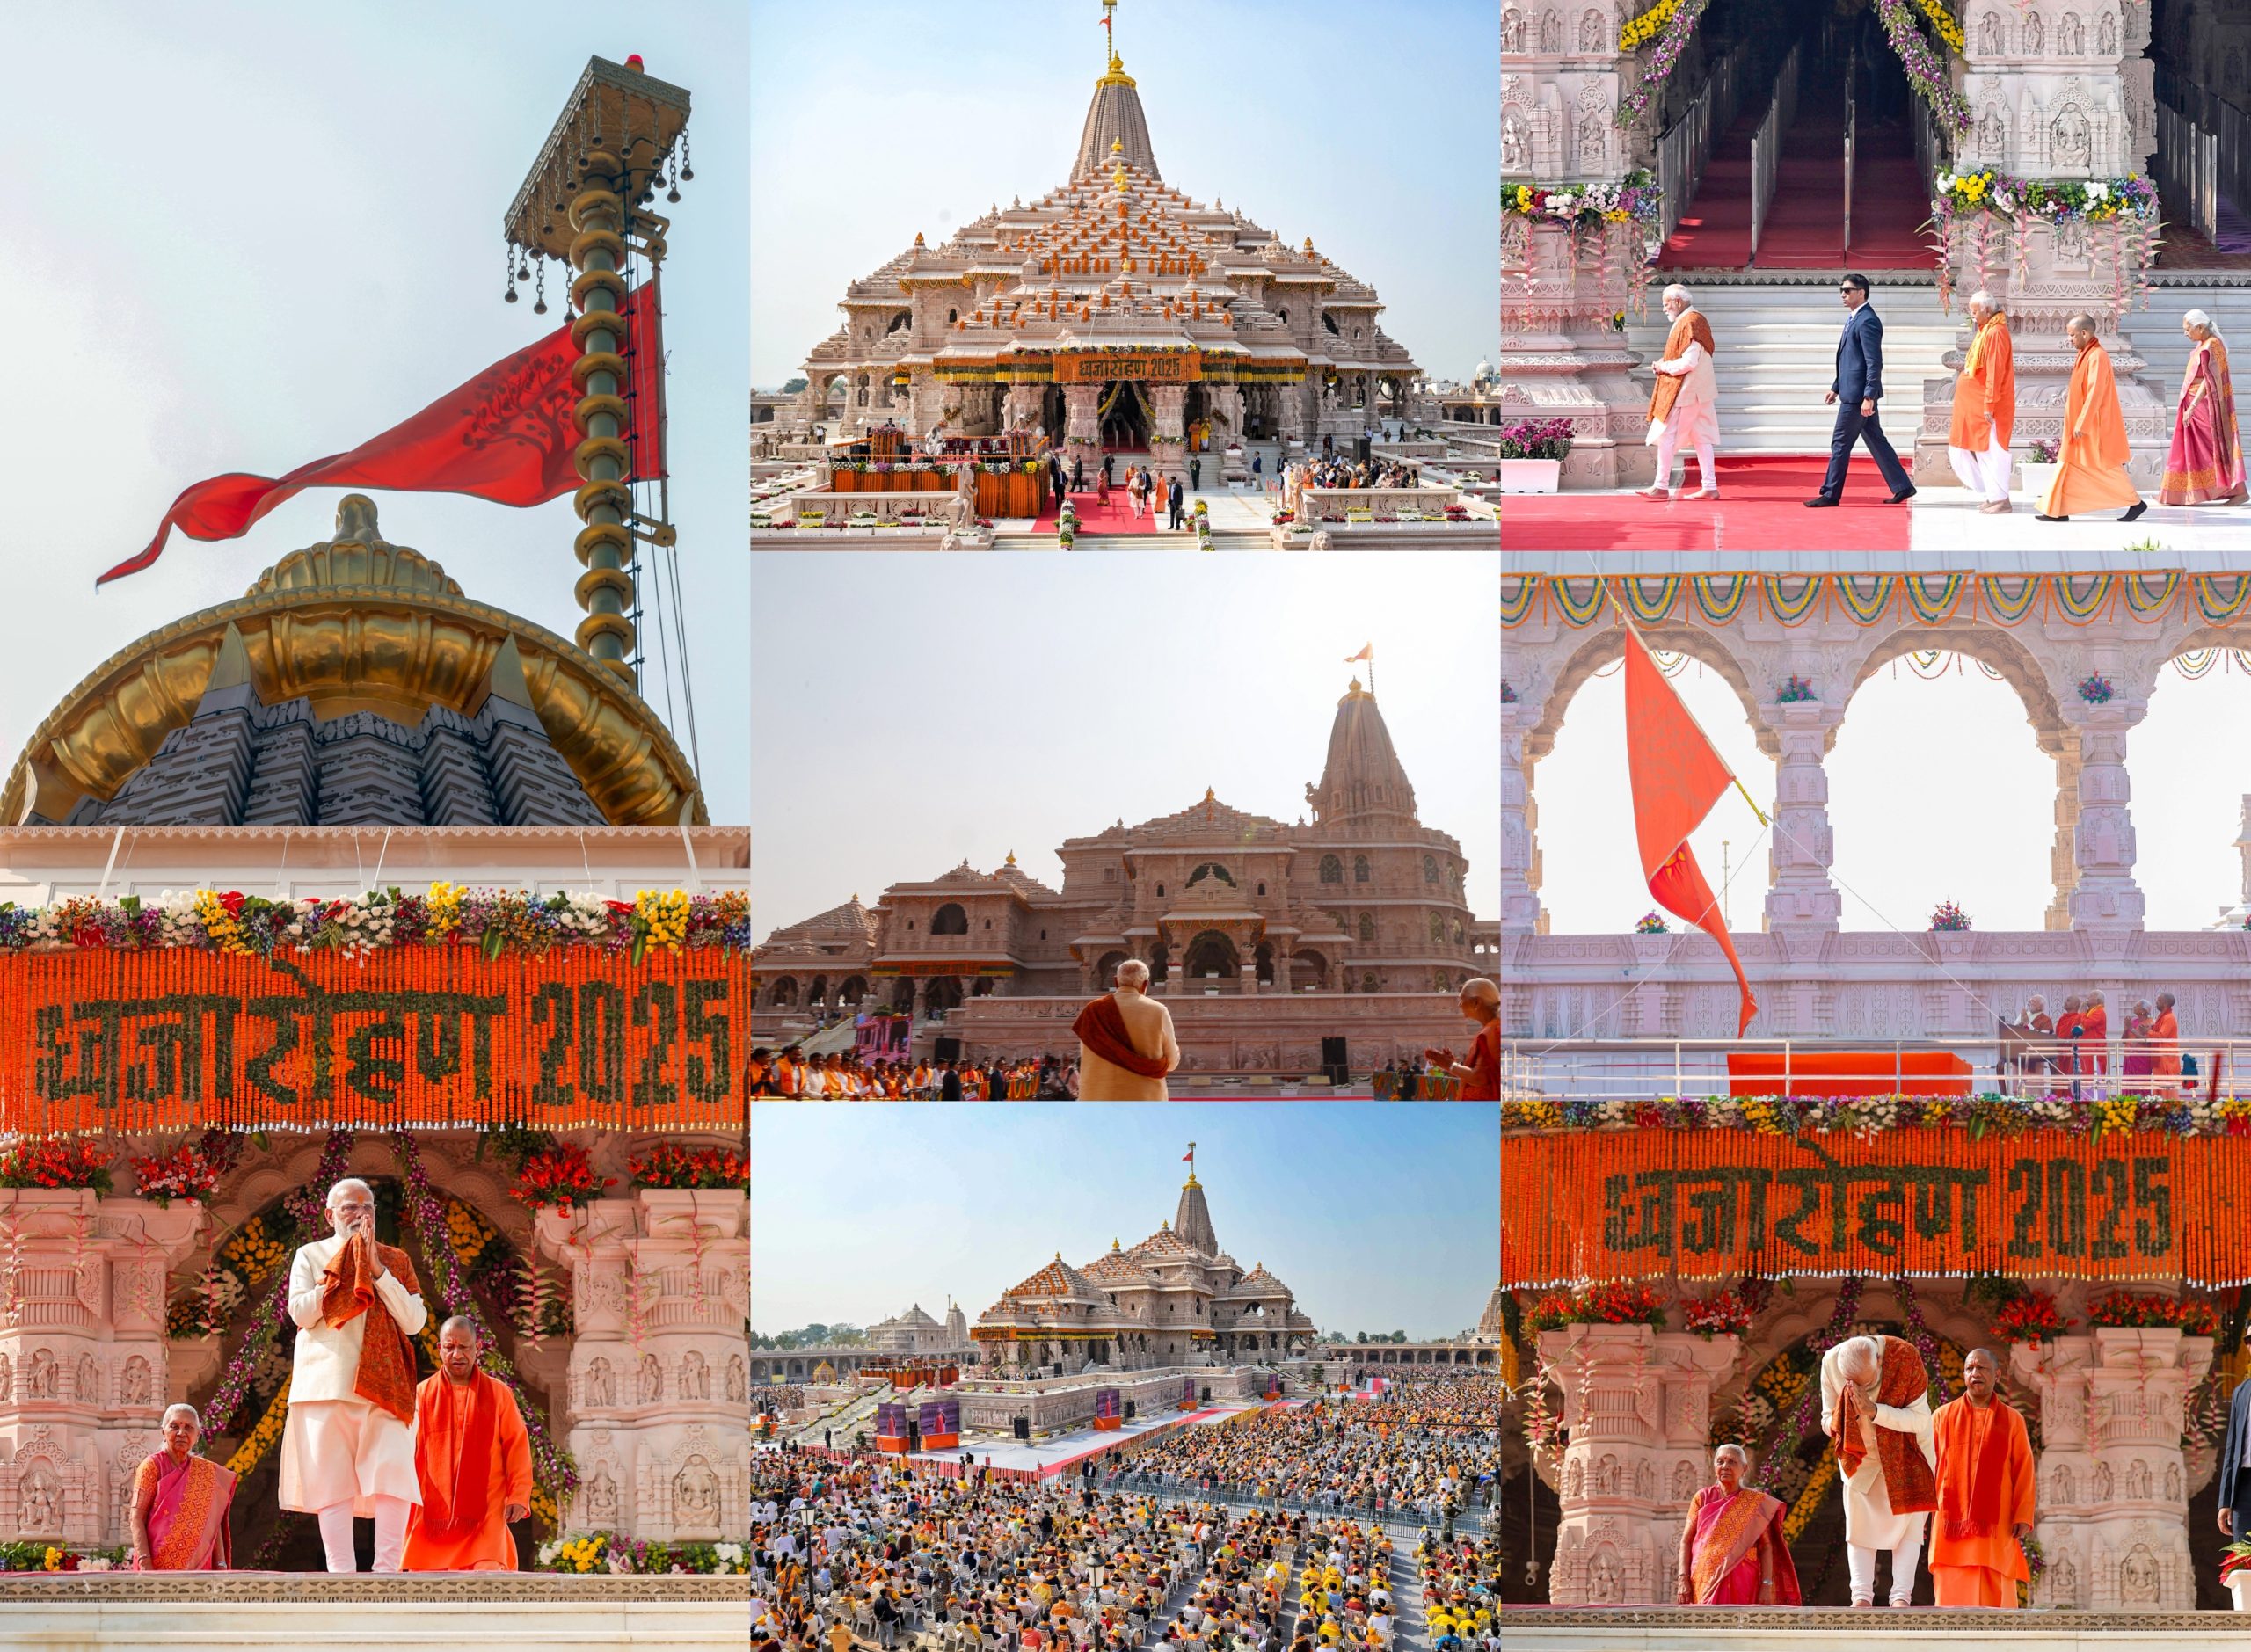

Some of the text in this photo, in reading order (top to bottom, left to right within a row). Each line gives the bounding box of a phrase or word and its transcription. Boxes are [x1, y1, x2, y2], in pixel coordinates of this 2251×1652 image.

[1150, 358, 1180, 376] 2025
[532, 979, 729, 1107] 2025
[2008, 1156, 2171, 1260] 2025
